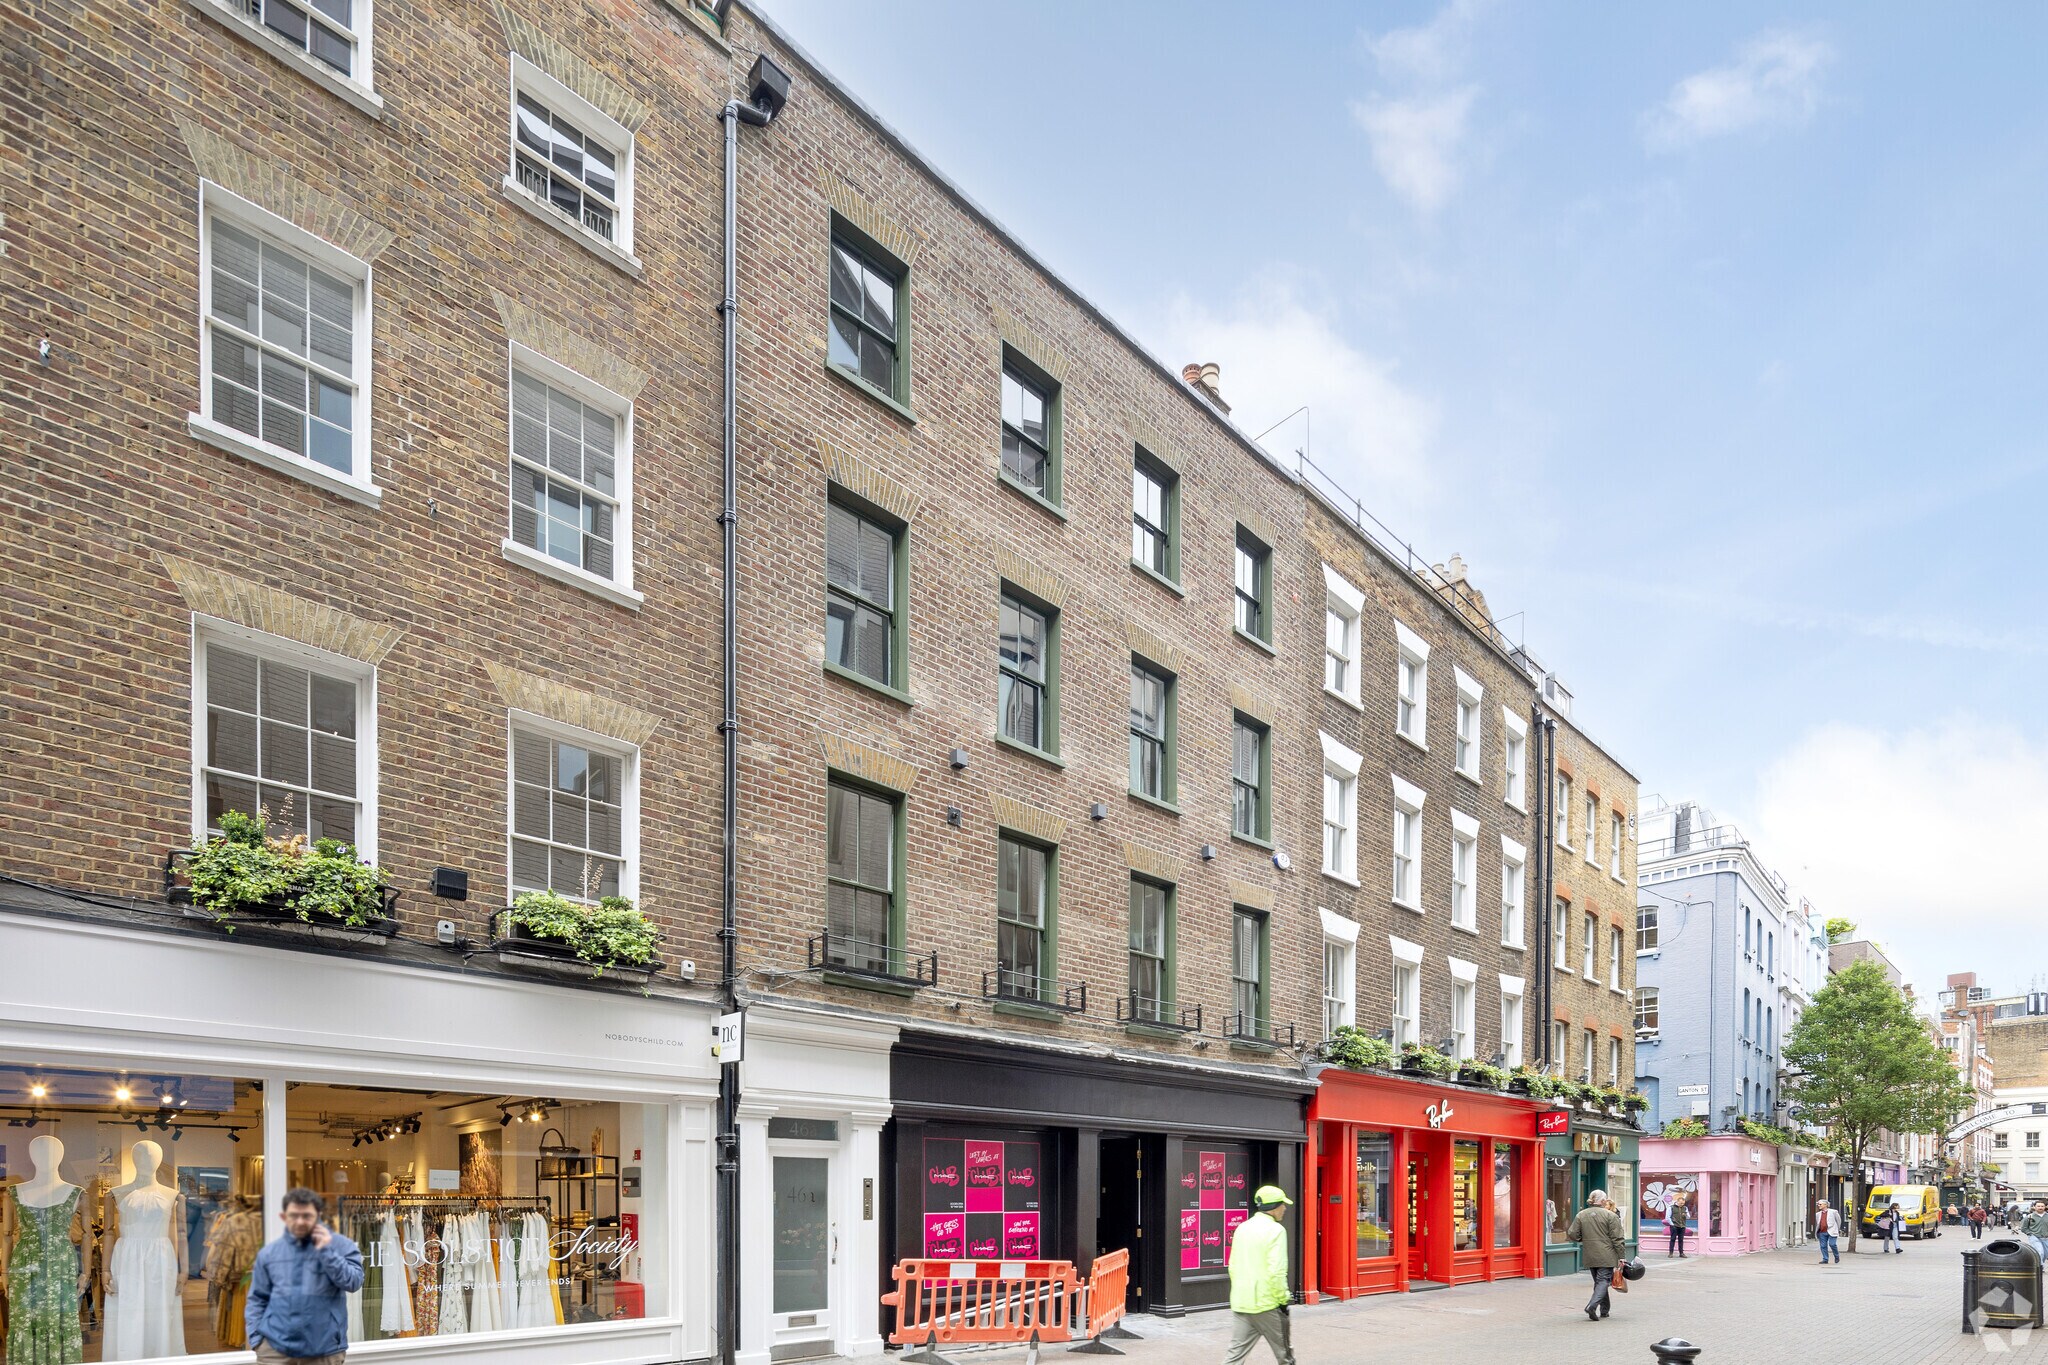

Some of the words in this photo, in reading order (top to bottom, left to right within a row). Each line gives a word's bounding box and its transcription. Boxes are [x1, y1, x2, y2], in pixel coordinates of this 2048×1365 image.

[605, 1033, 684, 1047] NOBODYSCHILD.COM
[722, 1025, 737, 1043] nc
[1959, 1113, 1996, 1133] WELCOME
[2004, 1109, 2016, 1117] TO
[1581, 1132, 1621, 1155] RIXO
[354, 1240, 394, 1268] HE
[402, 1236, 541, 1267] SOLSTICE
[547, 1224, 639, 1270] Society
[424, 1283, 461, 1293] WHERE
[464, 1281, 507, 1291] SUMMER
[511, 1279, 542, 1288] NEVER
